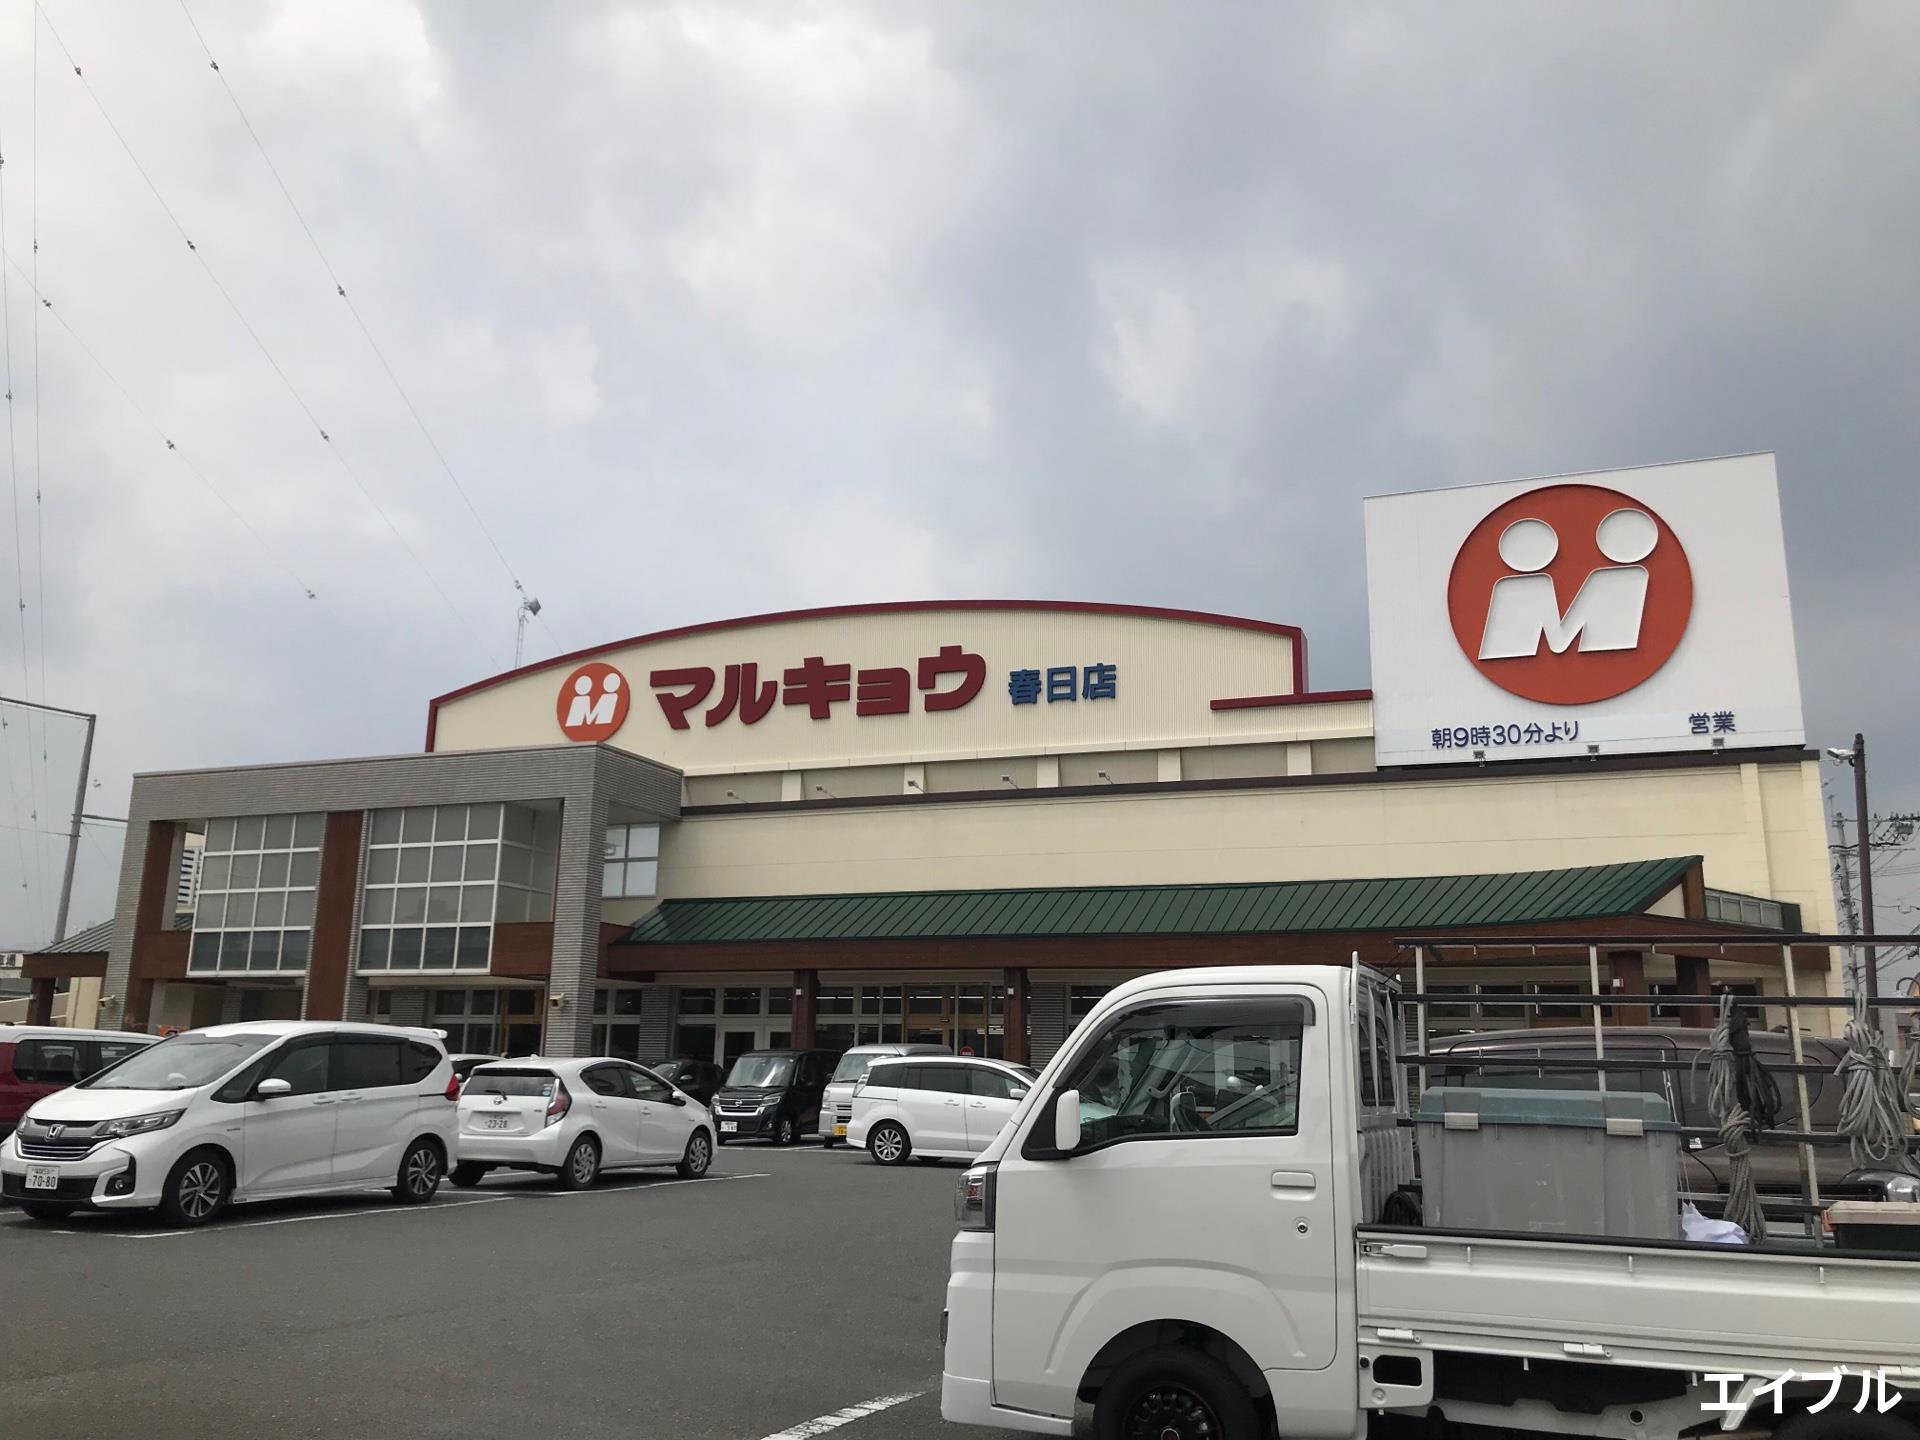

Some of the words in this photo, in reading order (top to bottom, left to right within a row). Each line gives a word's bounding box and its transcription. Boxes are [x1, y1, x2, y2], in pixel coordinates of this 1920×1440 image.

[650, 645, 987, 731] マルキョウ
[1008, 662, 1117, 706] 春日店
[1431, 720, 1580, 750] 朝9時30分より
[1688, 711, 1737, 735] 営業
[32, 1175, 56, 1187] 70-80
